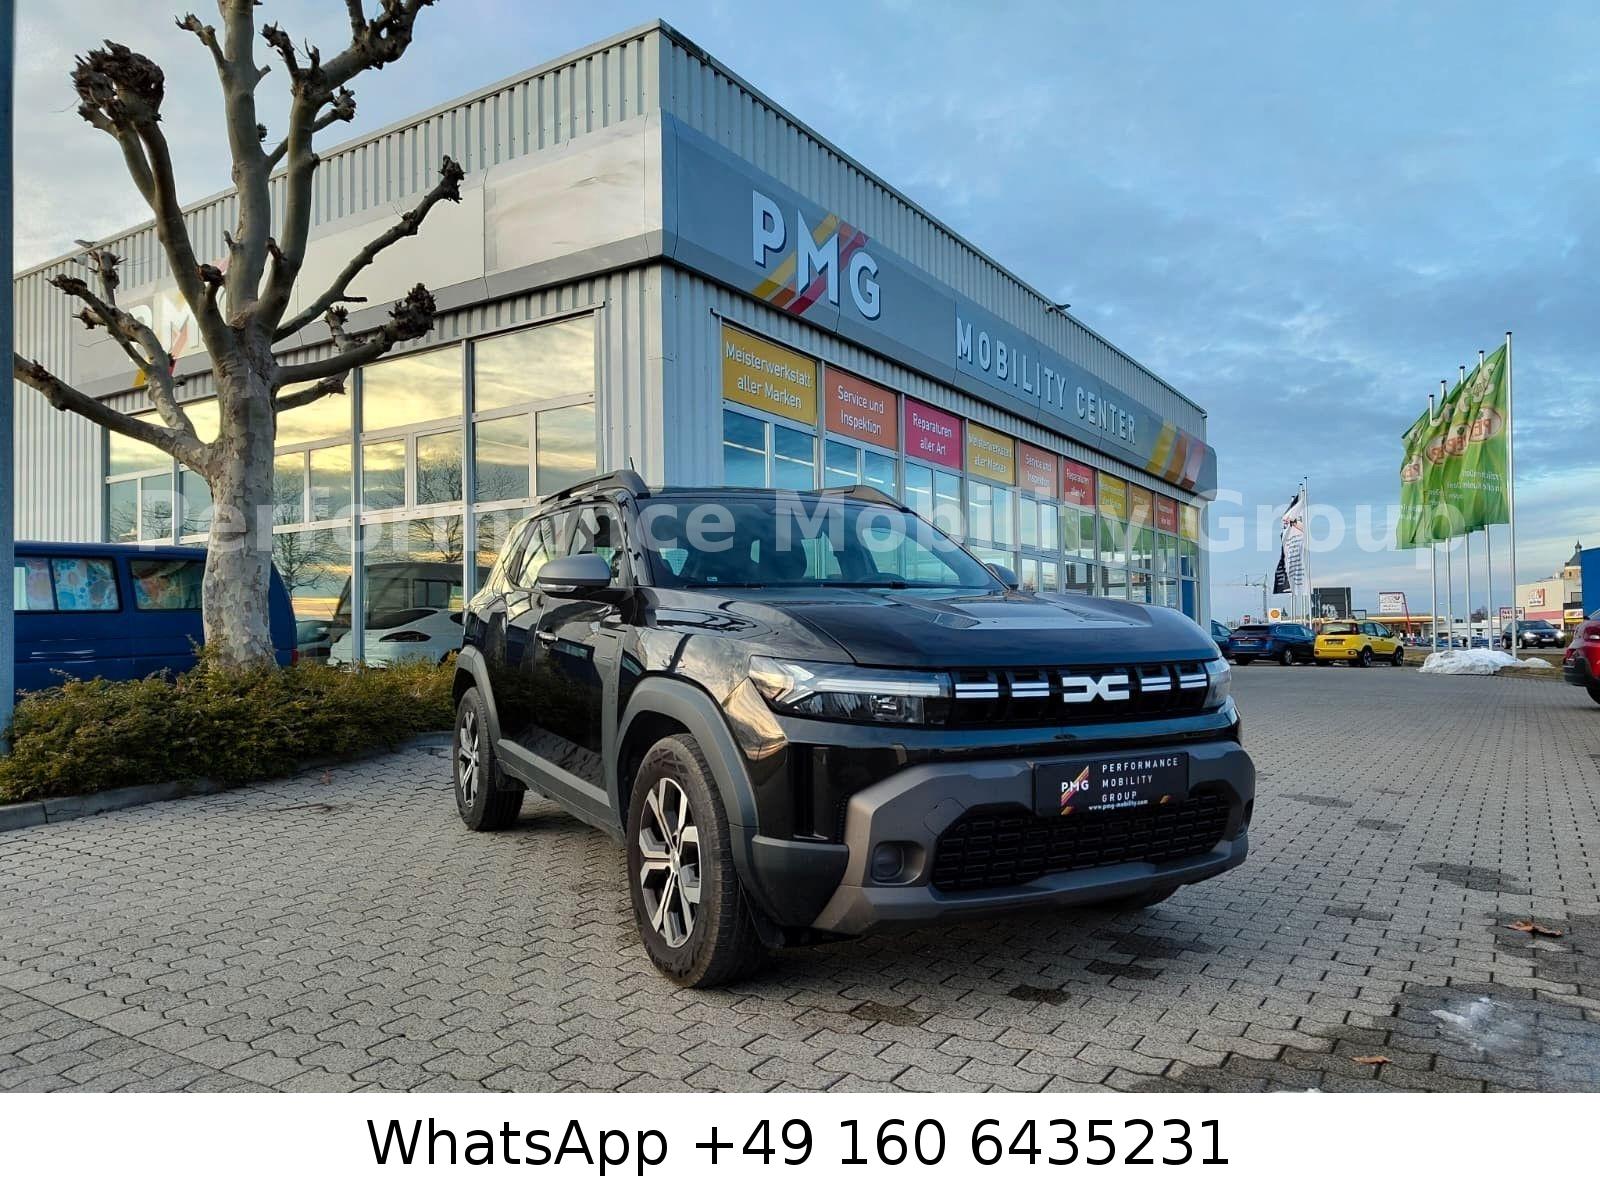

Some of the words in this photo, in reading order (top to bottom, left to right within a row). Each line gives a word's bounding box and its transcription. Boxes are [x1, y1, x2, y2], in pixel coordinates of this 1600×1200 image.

[753, 189, 881, 321] PMG
[726, 342, 812, 387] Meisterwerkstatt
[737, 375, 763, 396] aller
[764, 382, 802, 409] Marken
[956, 317, 1067, 410] MOBILITY
[1076, 386, 1136, 445] CENTER
[837, 384, 868, 408] Service
[869, 397, 884, 414] und
[840, 409, 881, 439] Inspektion
[912, 413, 952, 438] Reparaturen
[920, 437, 936, 453] aller
[936, 443, 946, 456] Art
[1102, 757, 1179, 774] PERFORMANCE
[1061, 780, 1090, 793] PMG
[1102, 775, 1153, 789] MOBILITY
[1102, 791, 1137, 803] GROUP
